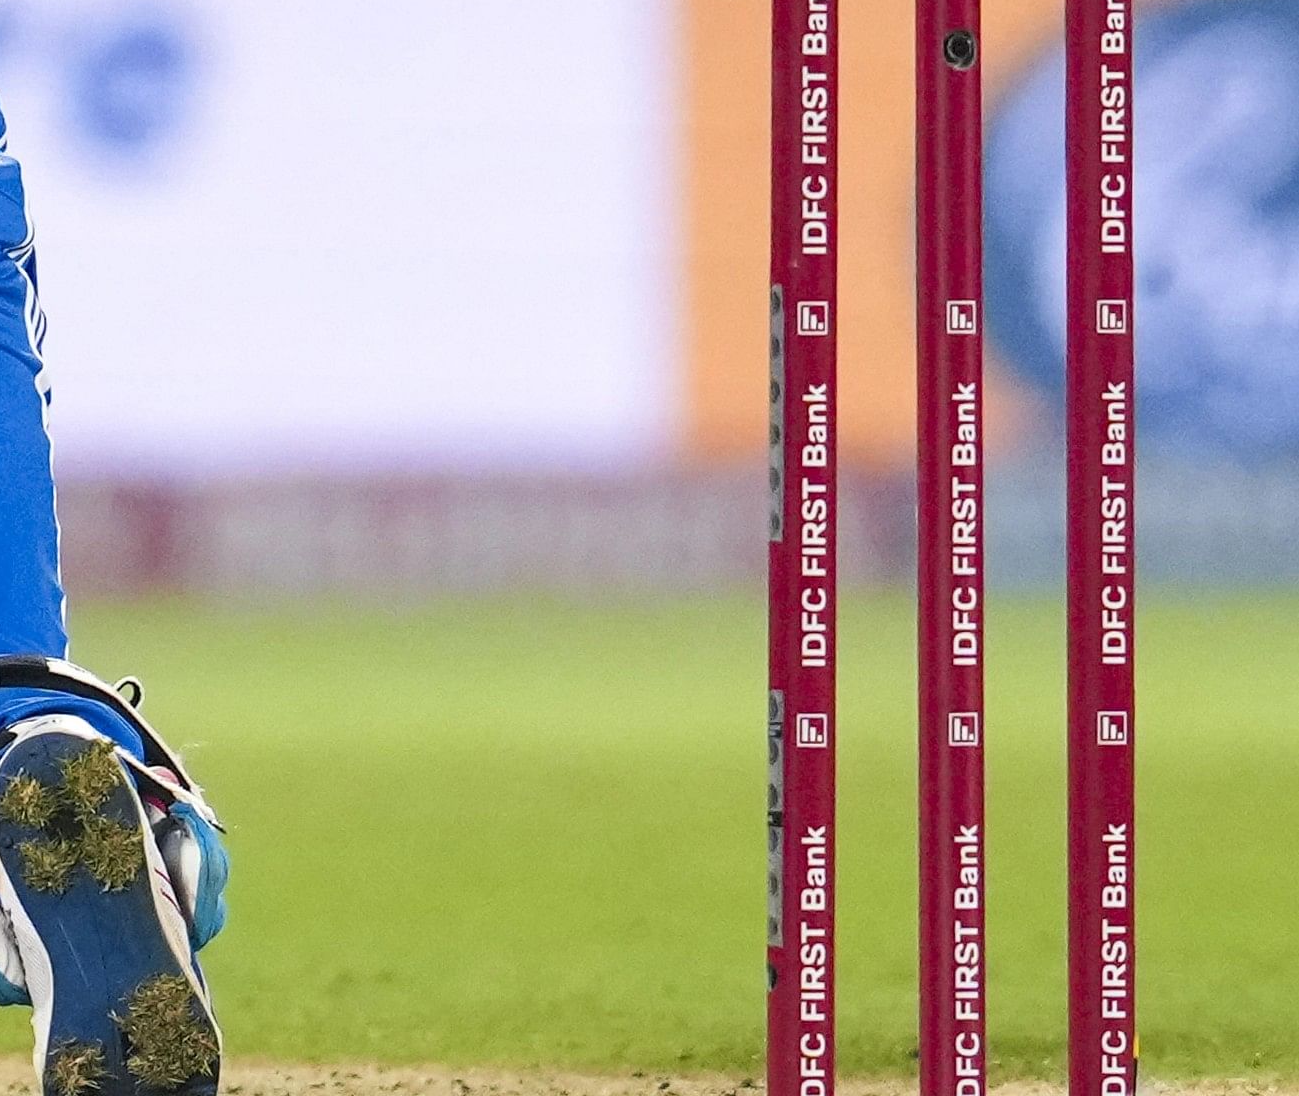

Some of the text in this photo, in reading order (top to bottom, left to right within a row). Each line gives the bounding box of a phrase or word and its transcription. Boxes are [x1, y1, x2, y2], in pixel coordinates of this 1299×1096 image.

[802, 66, 827, 164] FIRST
[1101, 65, 1125, 162] FIRST
[802, 176, 827, 254] IDFC
[1101, 175, 1125, 252] IDFC
[802, 384, 827, 666] IDFC FIRST Bank
[952, 383, 976, 665] IDFC FIRST Bank
[1102, 382, 1126, 664] IDFC FIRST Bank
[800, 827, 826, 910] Bank
[955, 825, 980, 909] Bank
[1102, 824, 1126, 907] Bank
[800, 922, 826, 1020] FIRST
[955, 921, 980, 1020] FIRST
[1102, 919, 1126, 1018] FIRST
